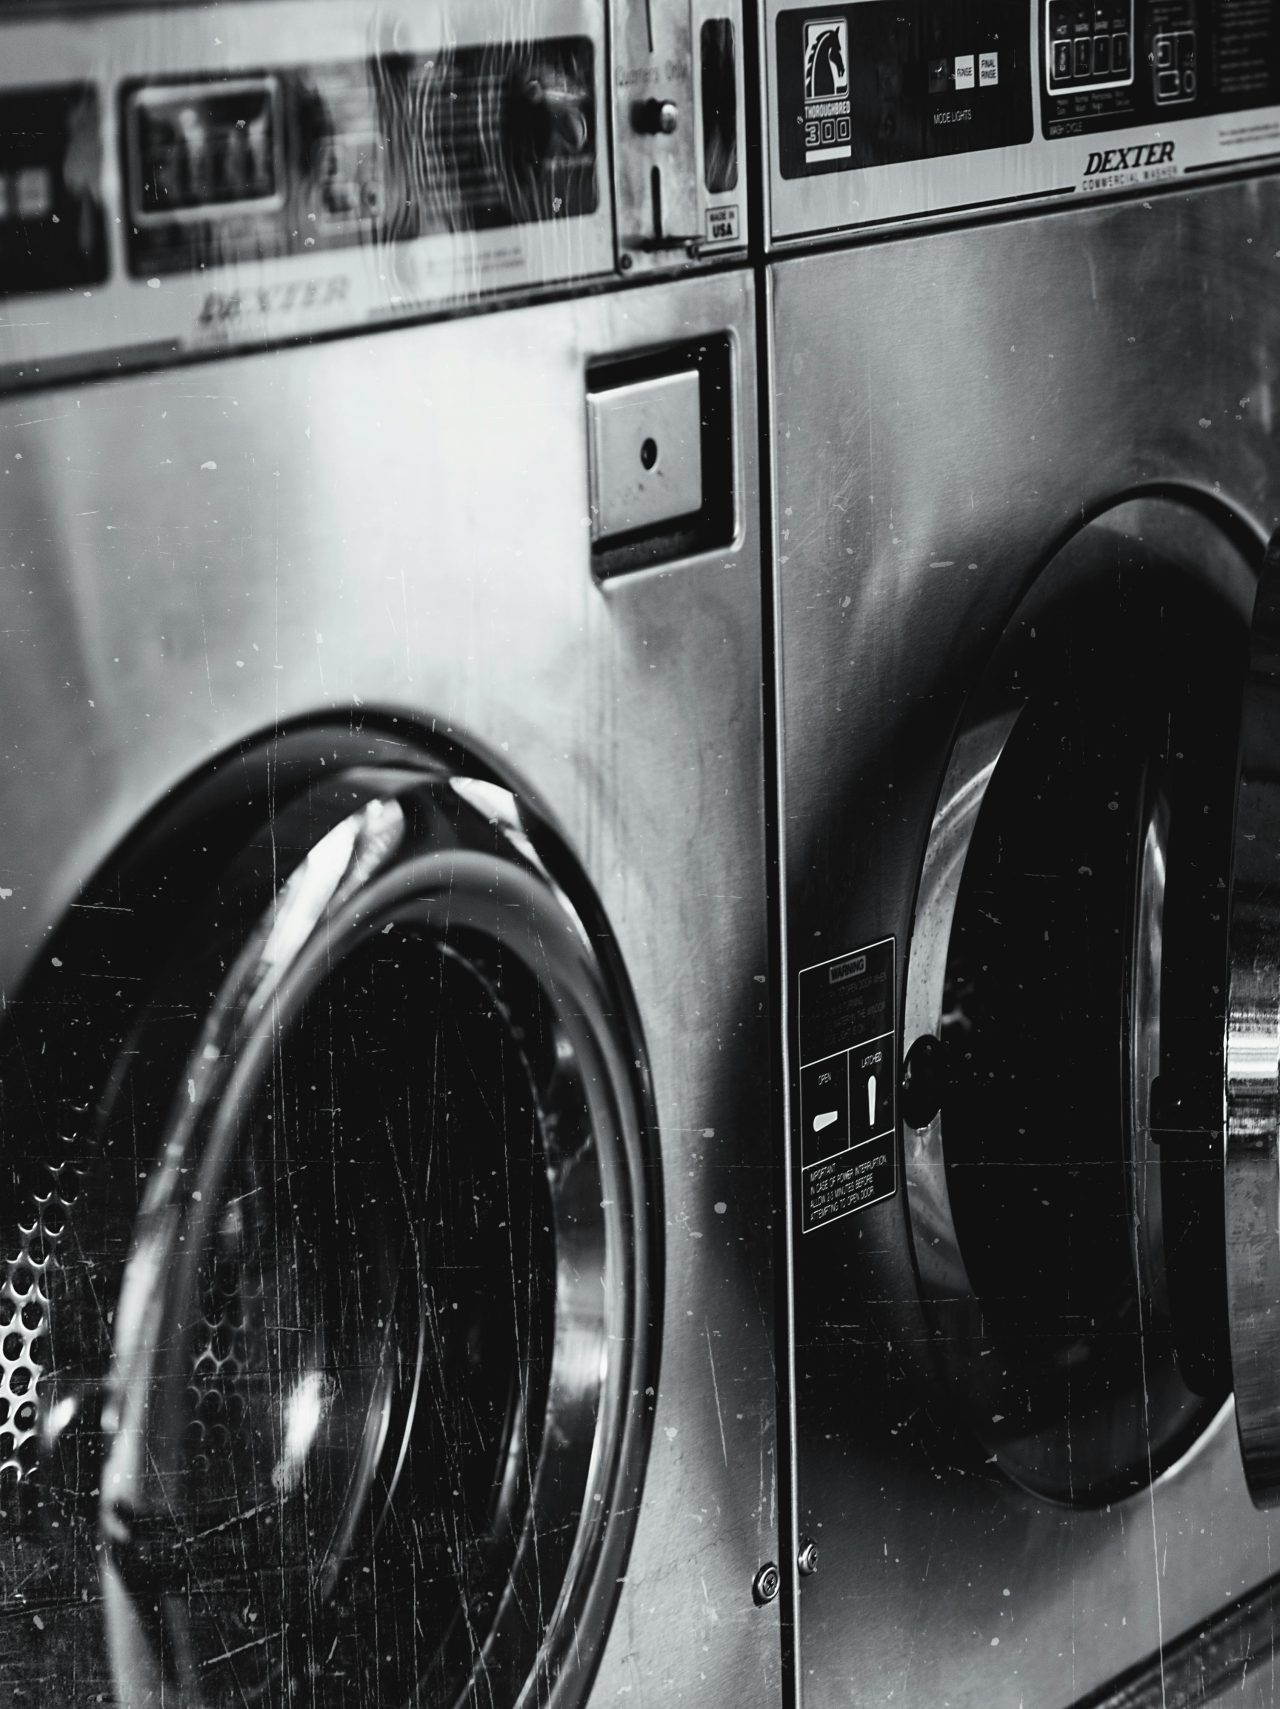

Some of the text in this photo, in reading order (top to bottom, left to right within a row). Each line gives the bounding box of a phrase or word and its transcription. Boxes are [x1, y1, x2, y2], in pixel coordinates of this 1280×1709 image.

[957, 66, 973, 77] RINSE
[981, 59, 996, 69] FINAL
[981, 69, 997, 79] RINSE
[804, 100, 851, 119] THOROUGHBRED
[933, 109, 972, 125] MODE LIGHTS
[804, 116, 852, 147] 300
[1083, 141, 1176, 176] DEXTER
[1083, 165, 1179, 191] COMMERCIAL WASHER
[710, 211, 727, 222] MADE
[712, 222, 733, 239] USA
[831, 957, 866, 982] WARNING
[861, 1050, 883, 1069] LATCHED
[817, 1071, 832, 1087] OPEN
[810, 1162, 836, 1182] IMPORTANT
[816, 1179, 829, 1194] CASE
[829, 1175, 837, 1188] OF
[837, 1168, 854, 1184] POWER
[854, 1154, 887, 1176] INTERRUPTION
[810, 1195, 826, 1209] ALLOW
[834, 1181, 855, 1198] MINUTES
[855, 1172, 873, 1190] BEFORE
[810, 1201, 839, 1221] ATTEMPTING
[847, 1192, 860, 1206] OPEN
